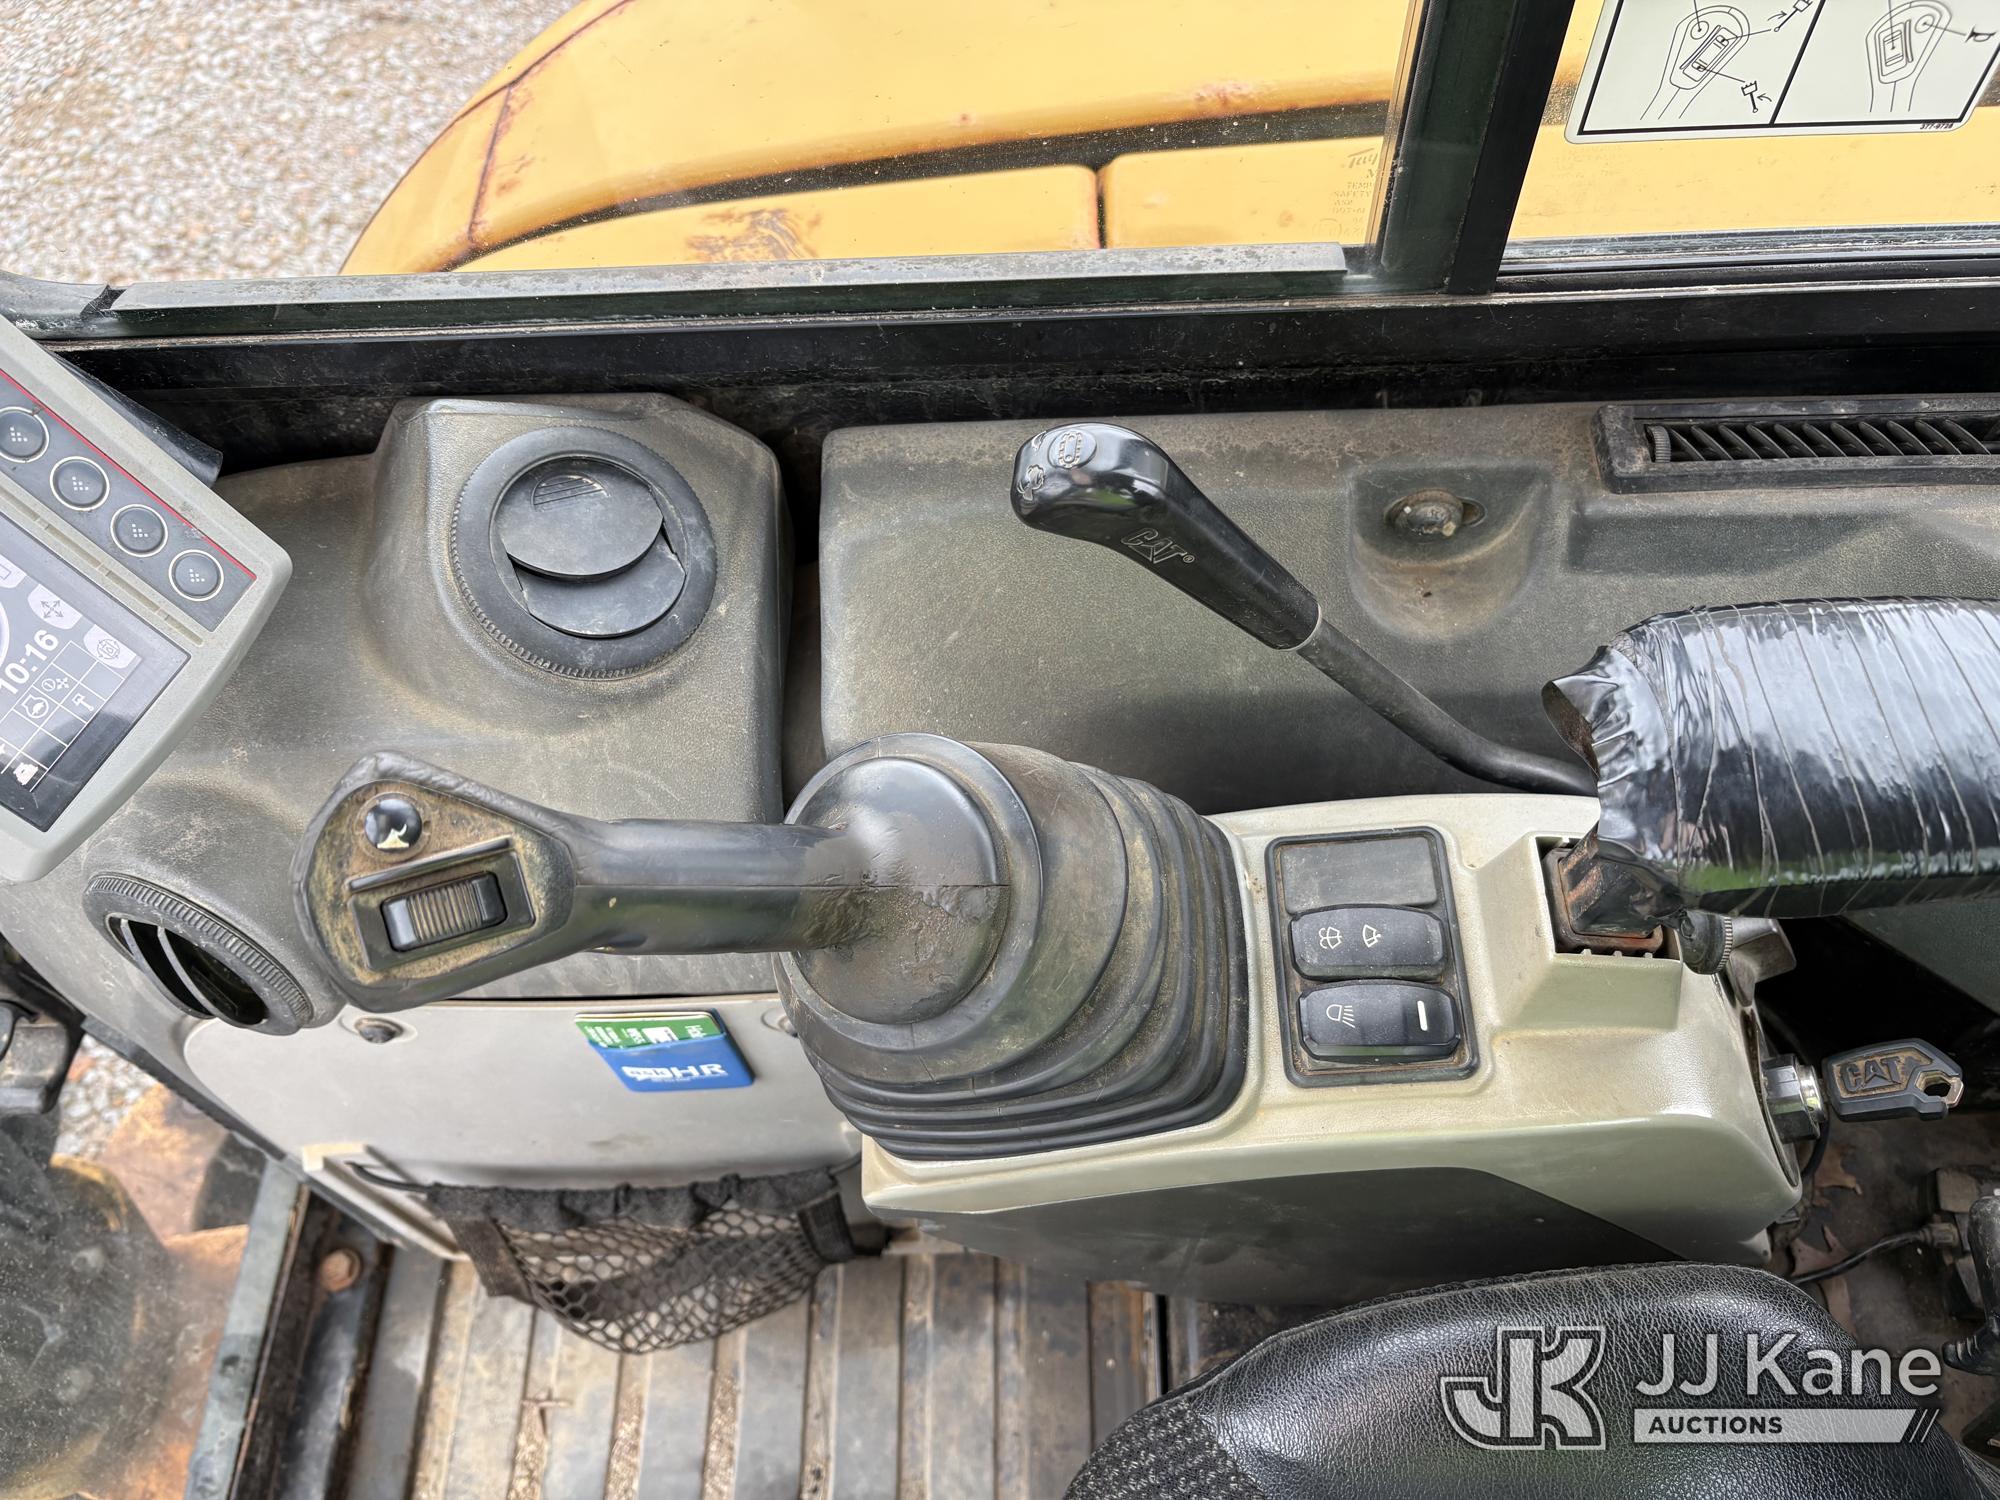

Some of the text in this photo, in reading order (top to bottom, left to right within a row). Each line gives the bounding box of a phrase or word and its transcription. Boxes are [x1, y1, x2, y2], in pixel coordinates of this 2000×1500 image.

[0, 629, 59, 695] 10:16
[669, 1063, 728, 1077] HR
[1839, 1055, 1902, 1093] CAT
